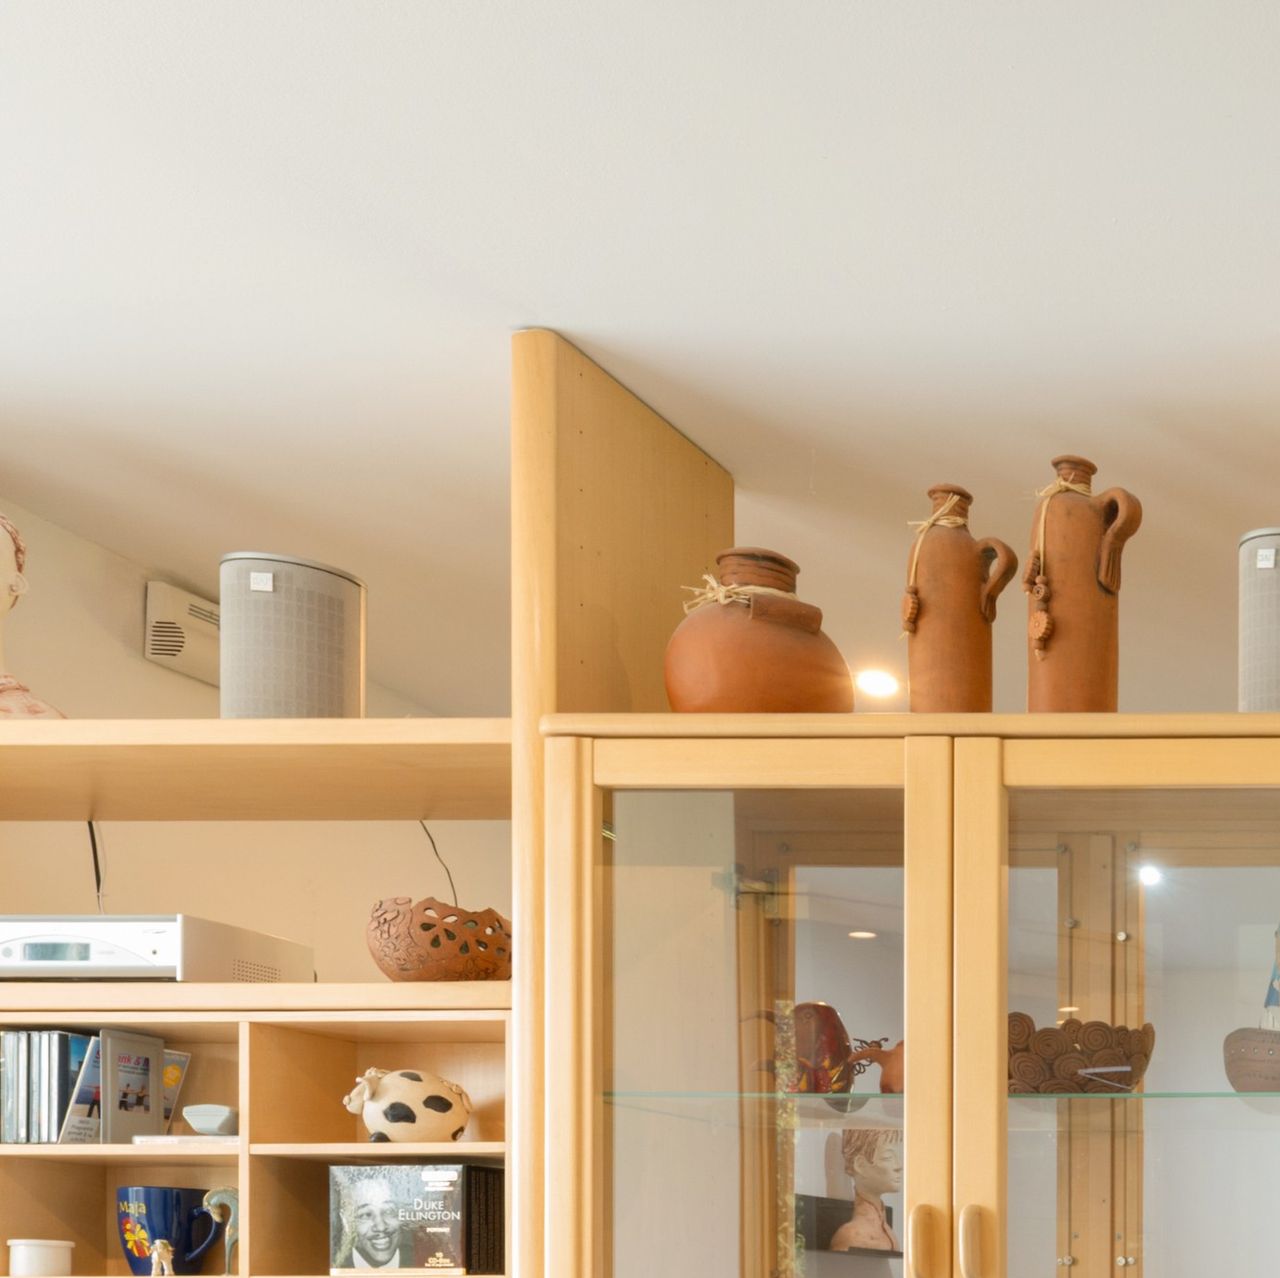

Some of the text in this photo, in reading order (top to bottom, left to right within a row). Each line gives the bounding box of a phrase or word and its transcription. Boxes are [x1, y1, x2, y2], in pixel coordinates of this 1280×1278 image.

[120, 1200, 147, 1217] Maja
[414, 1198, 445, 1210] DUKE
[398, 1208, 460, 1220] ELLINGTON
